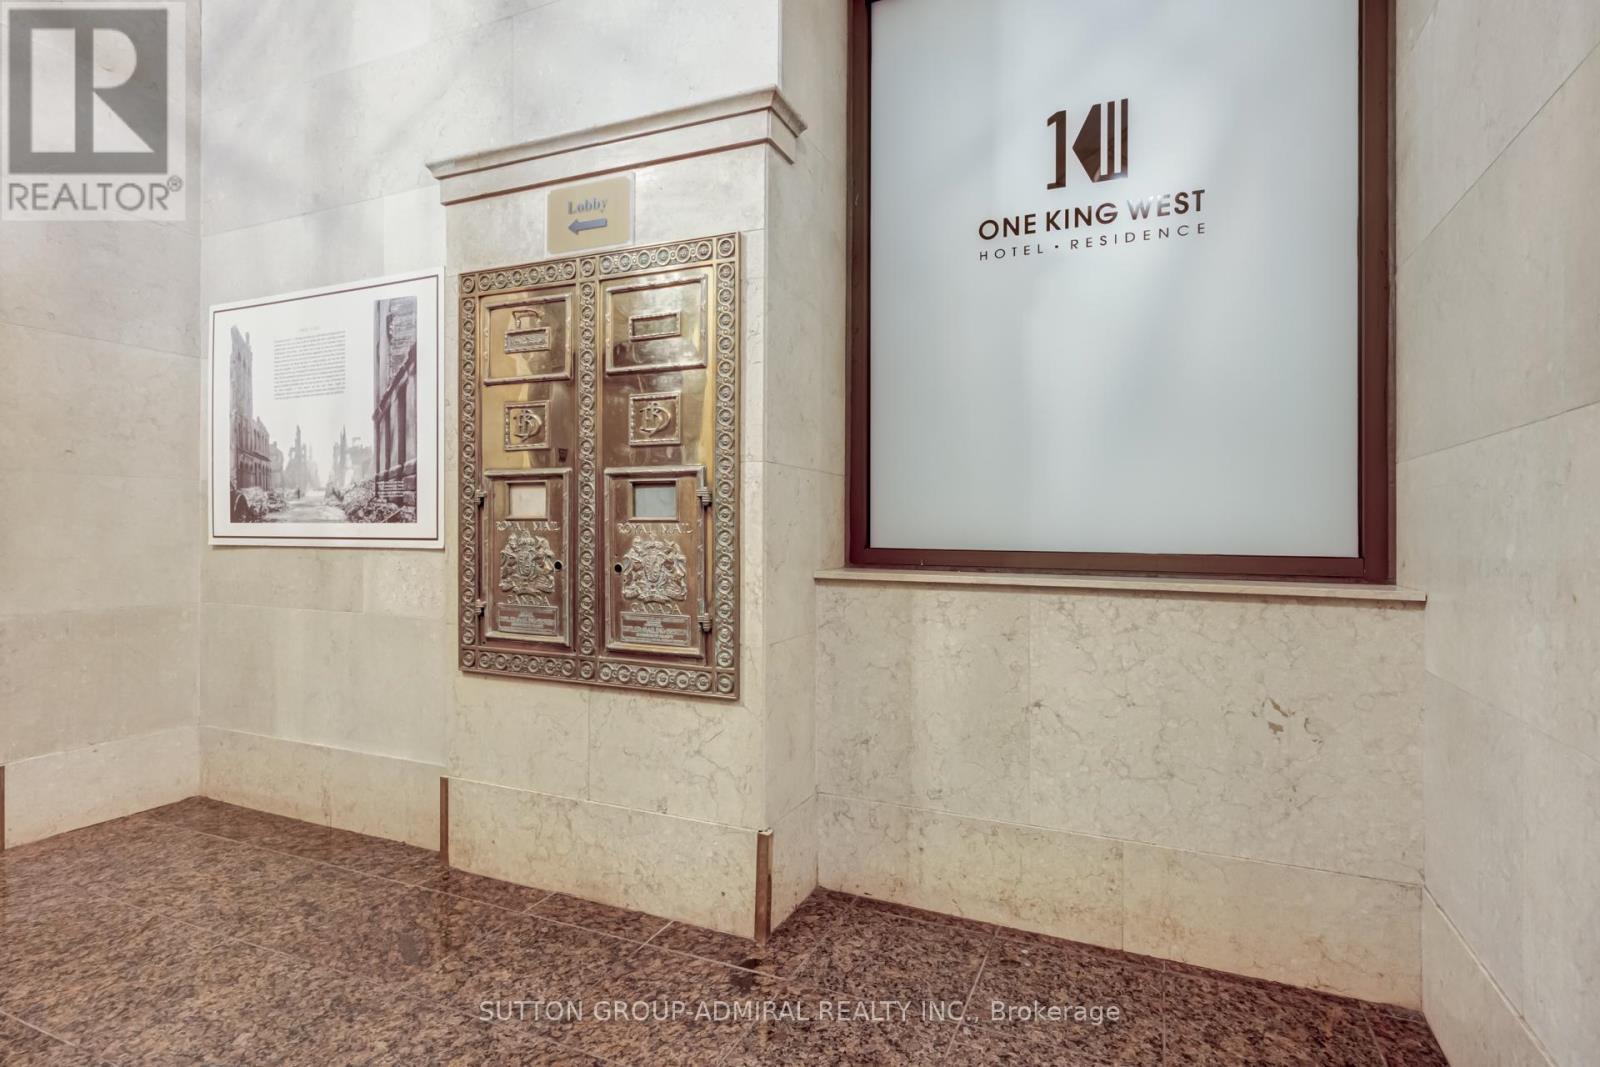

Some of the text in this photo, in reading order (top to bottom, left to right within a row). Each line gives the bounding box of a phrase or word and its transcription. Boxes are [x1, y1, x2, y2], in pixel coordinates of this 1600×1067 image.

[568, 197, 607, 215] Lobby
[979, 189, 1205, 240] ONE KING WEST
[979, 222, 1206, 261] HOTEL RESIDENCE
[631, 602, 682, 615] CANADA
